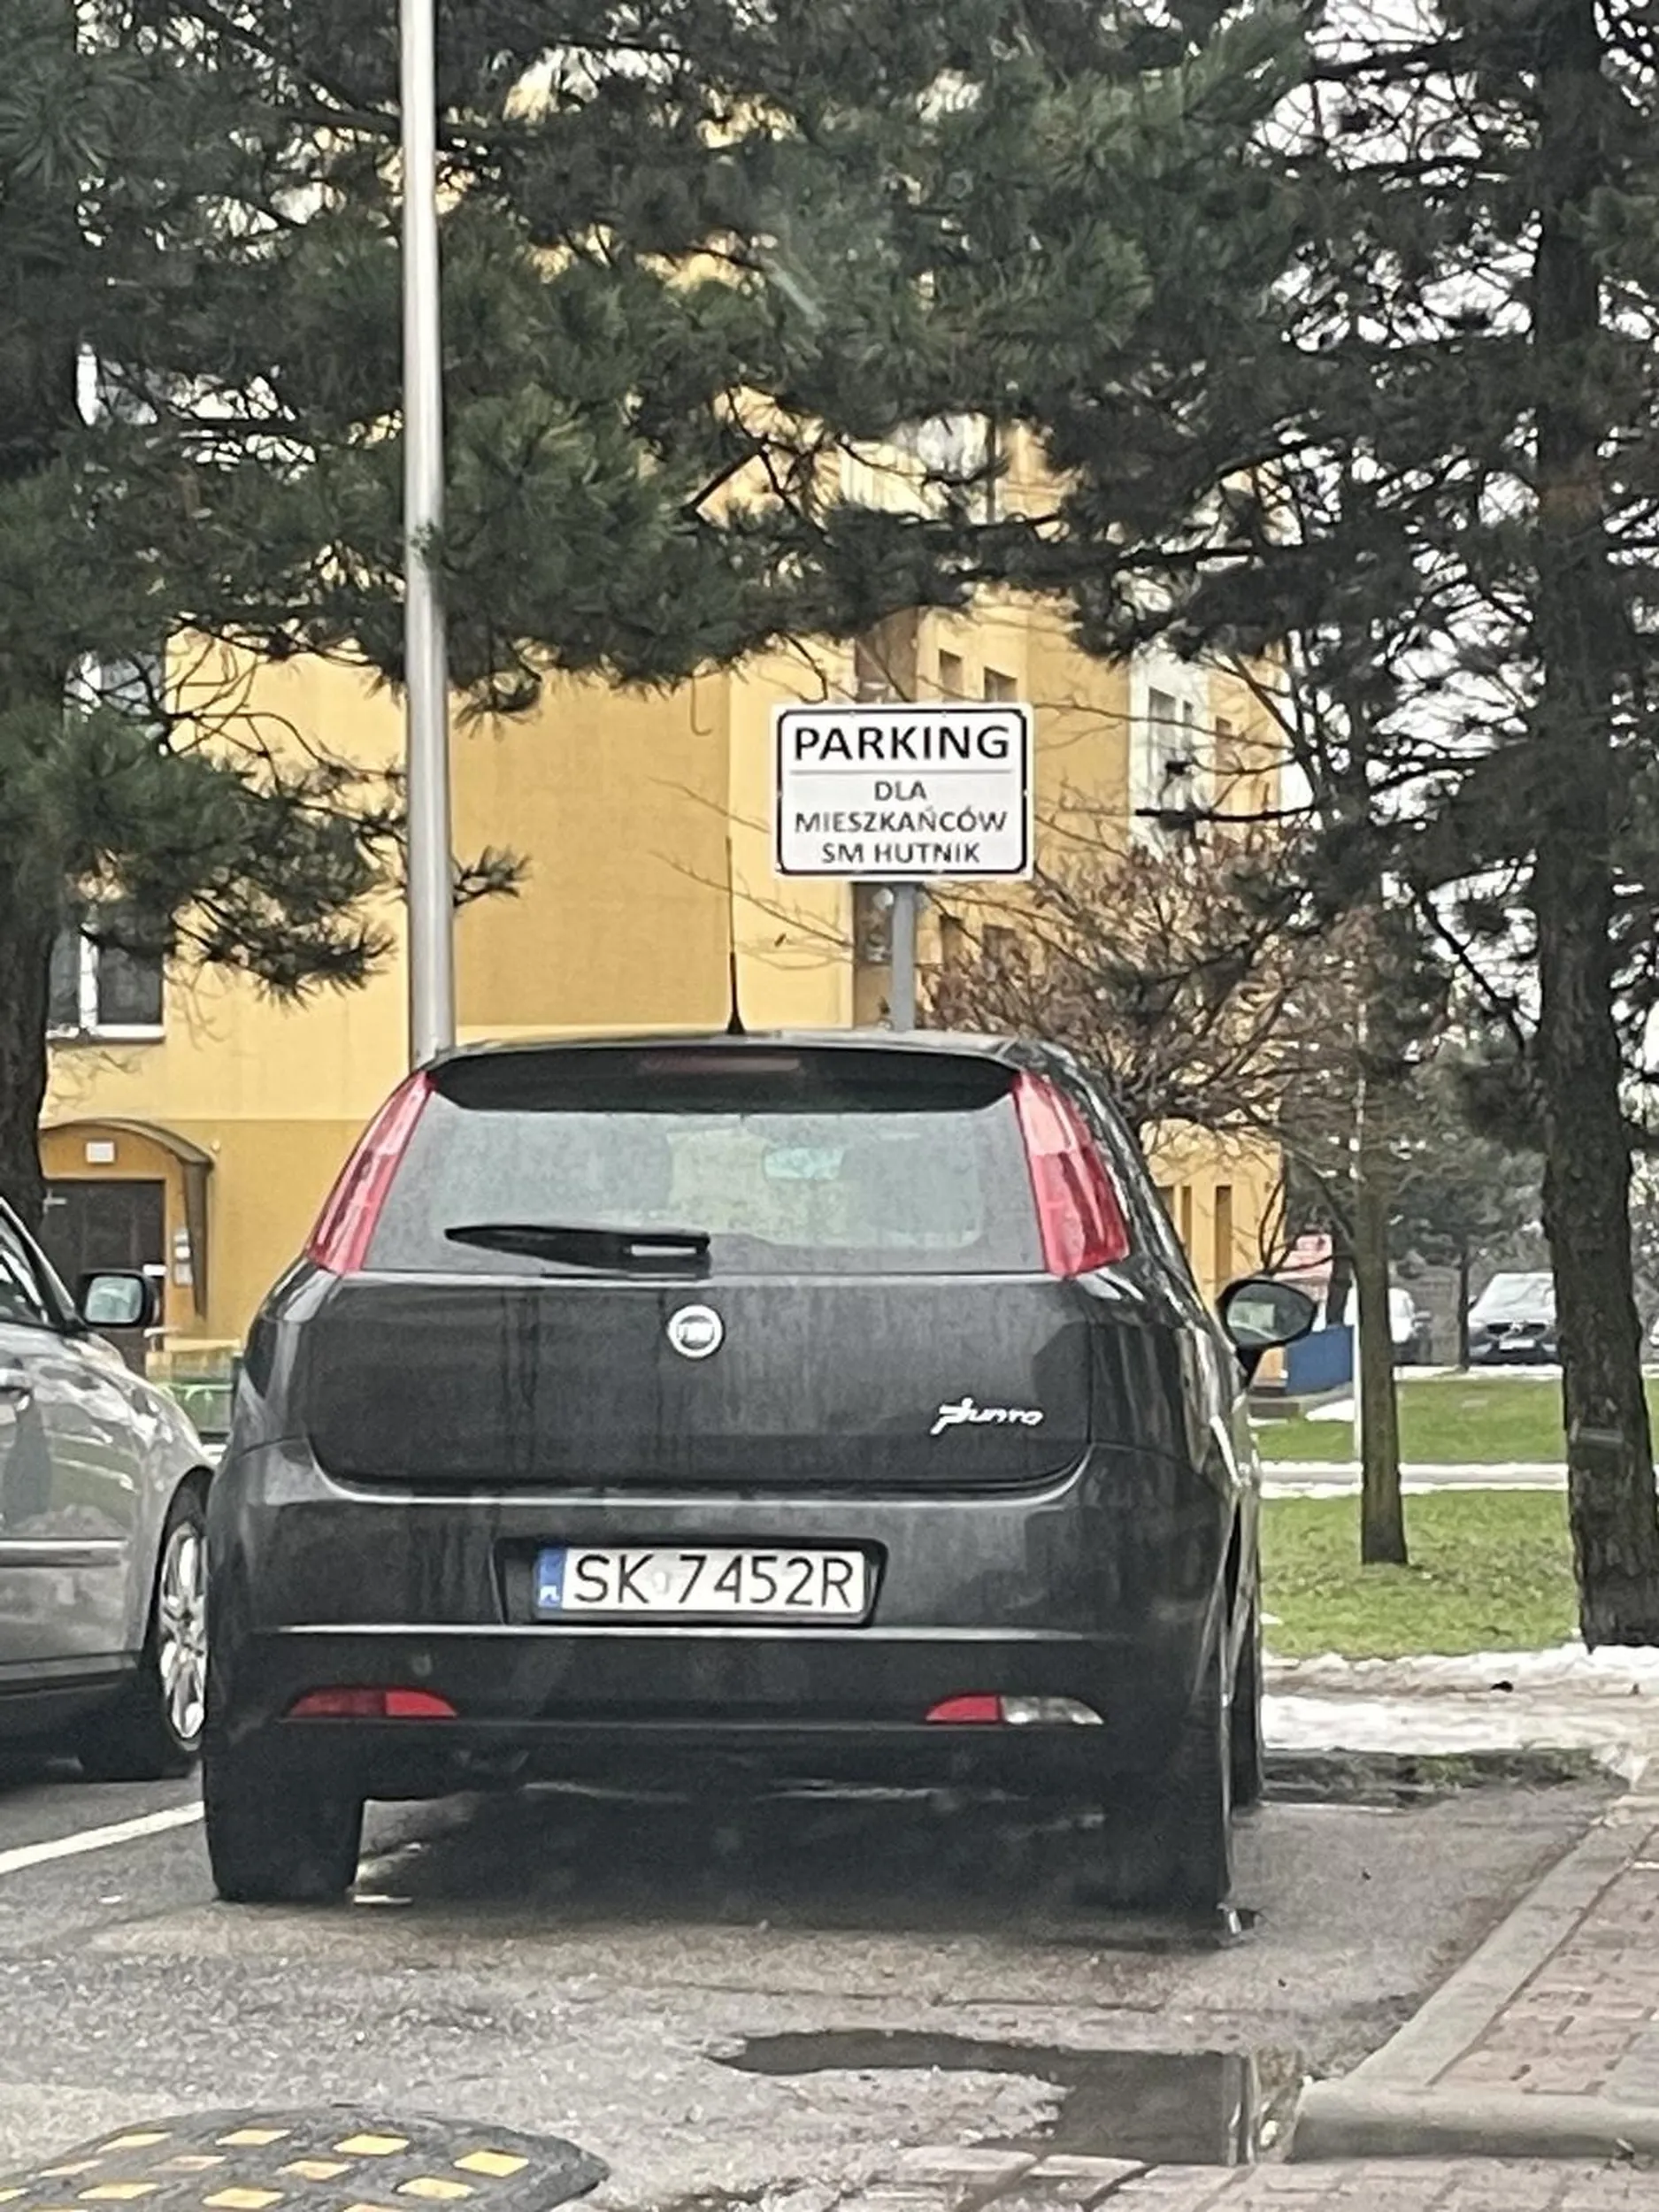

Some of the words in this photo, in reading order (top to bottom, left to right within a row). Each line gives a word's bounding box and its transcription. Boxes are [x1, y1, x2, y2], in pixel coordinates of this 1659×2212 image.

[795, 726, 1009, 760] PARKING
[874, 780, 927, 801] DLA
[795, 805, 1007, 833] MIESZKAŃCÓW
[822, 842, 864, 864] SM
[874, 842, 979, 864] HUTNIK
[575, 1554, 653, 1603] SK
[679, 1555, 855, 1608] 7452R
